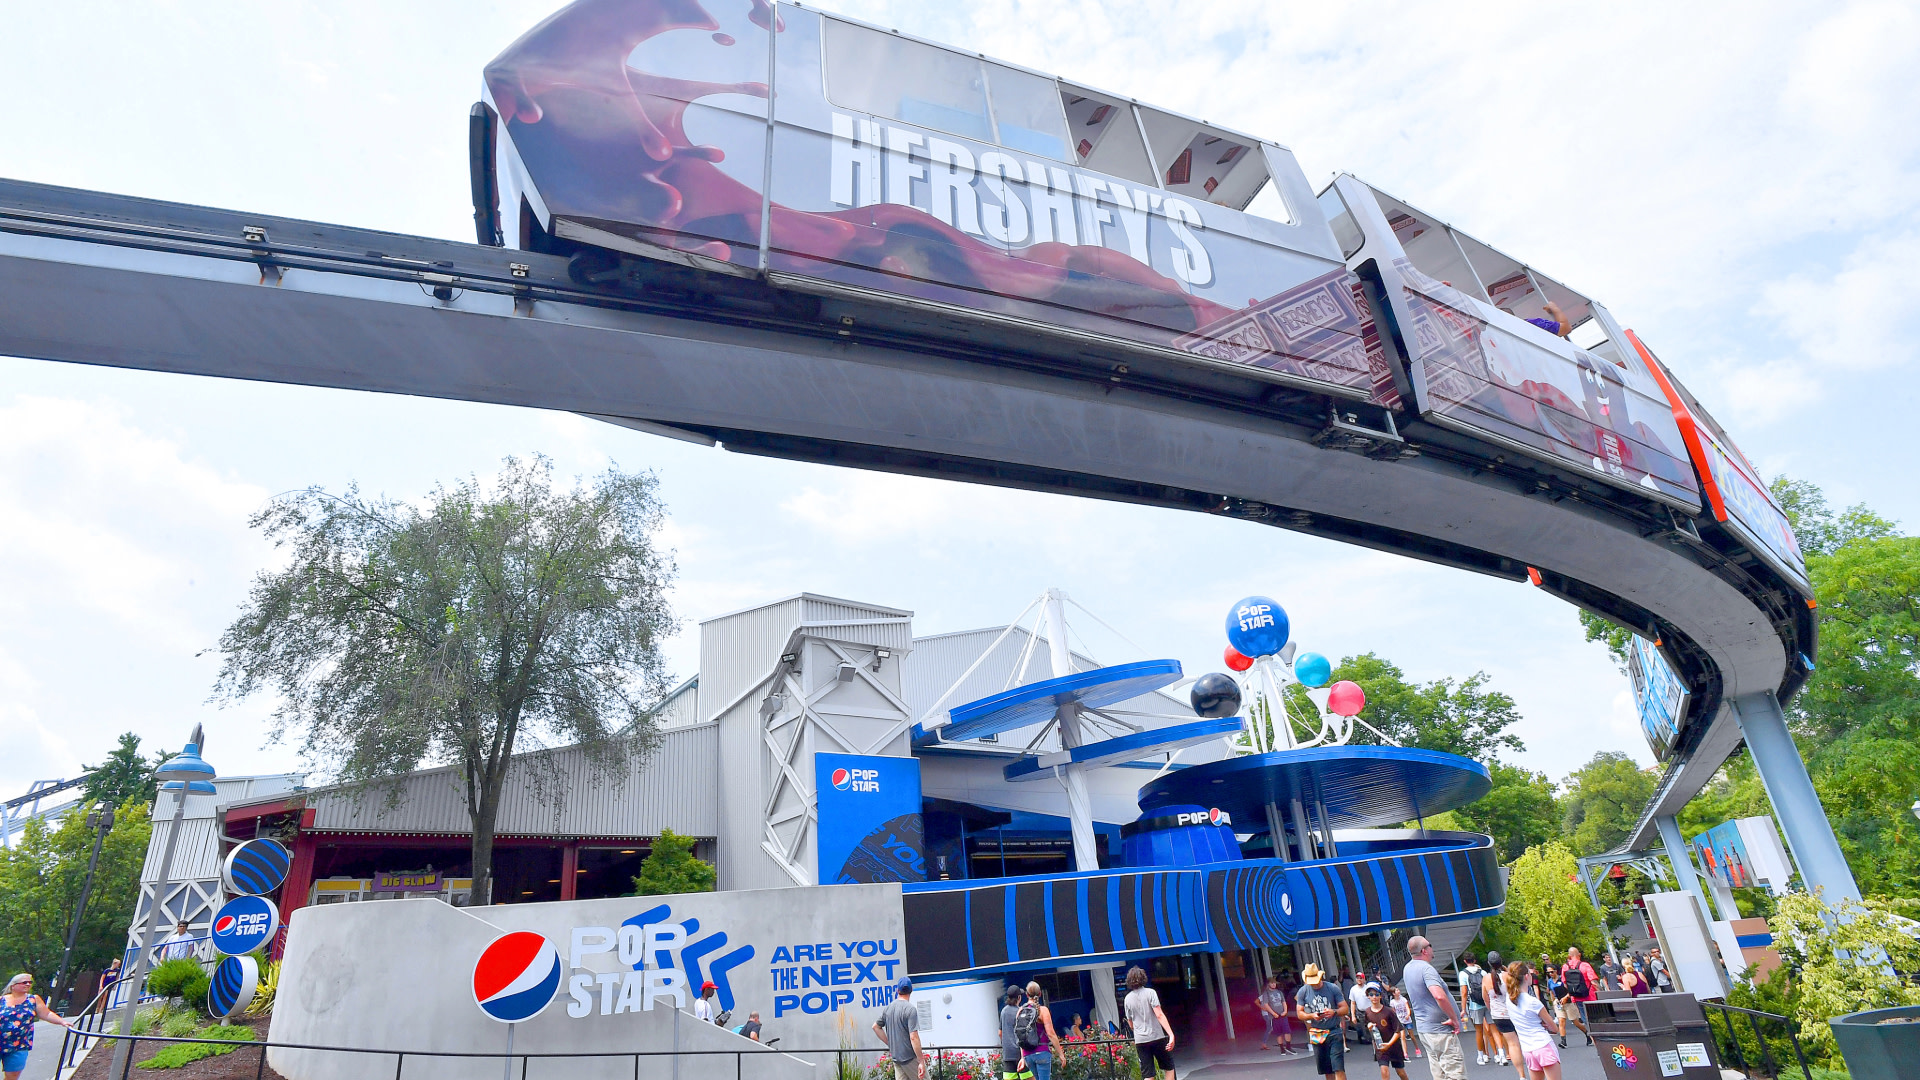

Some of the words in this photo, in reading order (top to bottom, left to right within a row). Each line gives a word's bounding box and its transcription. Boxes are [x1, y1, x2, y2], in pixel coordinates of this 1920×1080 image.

[830, 112, 1213, 288] HERSHEY'S
[1278, 294, 1337, 333] HERSHEY'S
[1237, 604, 1271, 621] POP
[1240, 614, 1275, 632] STAR
[851, 768, 879, 781] POP
[851, 780, 880, 792] STAR
[1177, 811, 1209, 826] POP
[381, 877, 400, 887] BIG
[403, 874, 436, 886] CLAW
[237, 913, 269, 925] POP
[235, 923, 267, 936] STAR
[570, 923, 687, 969] POP
[770, 943, 833, 964] ARE
[838, 938, 898, 958] YOU
[770, 966, 799, 991] THE
[801, 959, 900, 989] NEXT
[567, 968, 686, 1019] STAR
[774, 989, 855, 1018] POP
